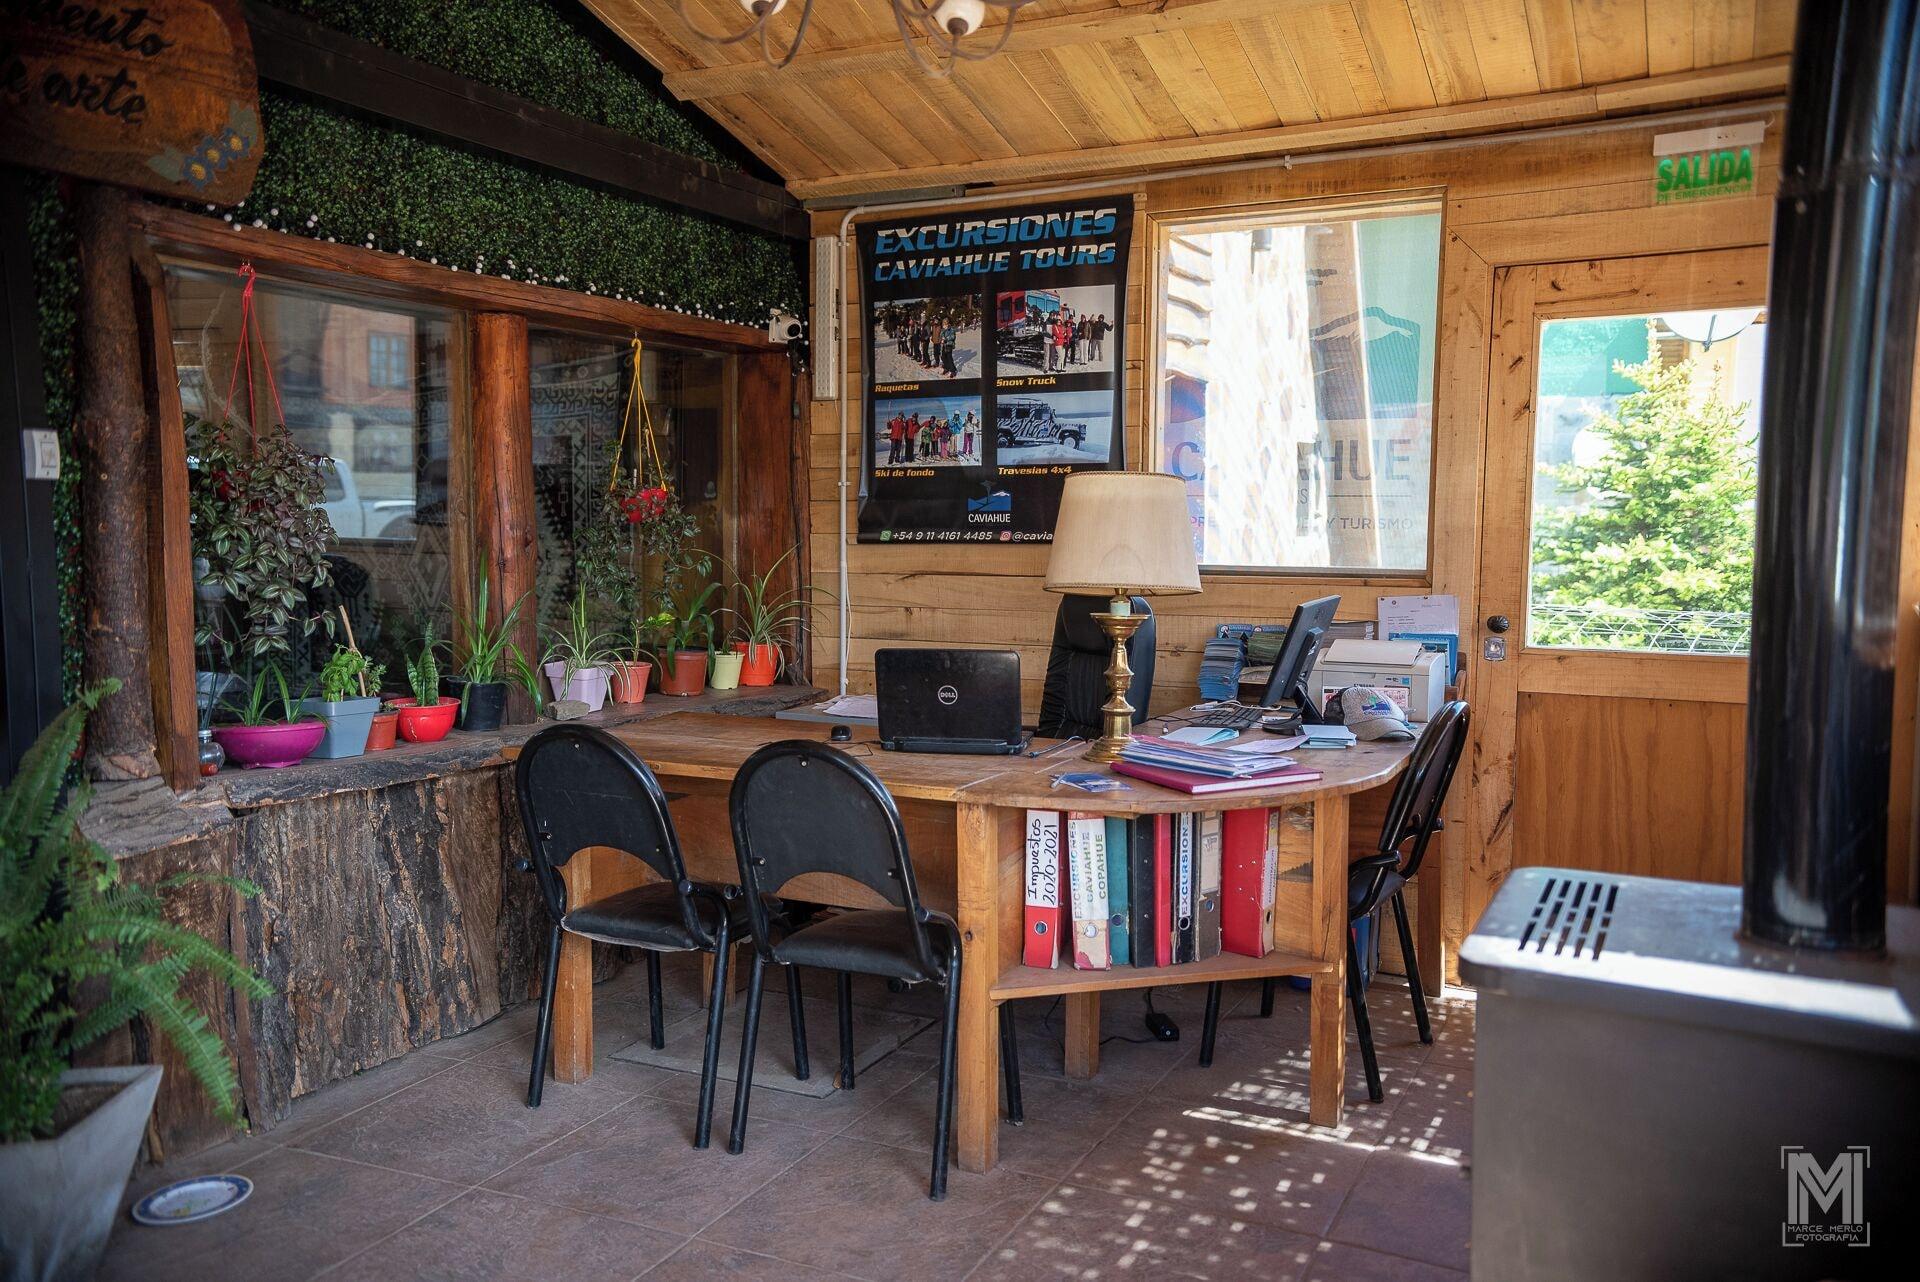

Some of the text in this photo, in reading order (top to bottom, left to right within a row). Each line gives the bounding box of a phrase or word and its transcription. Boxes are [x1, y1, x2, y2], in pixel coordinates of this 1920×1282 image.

[43, 67, 146, 124] arte
[1657, 148, 1752, 191] SALIDA
[874, 208, 1117, 254] EXCURSIONES
[874, 242, 1116, 282] CAVIAHUE TOURS
[875, 383, 919, 393] Raquetas
[996, 376, 1056, 387] Snow Truck
[875, 468, 935, 477] Ski de fondo
[998, 465, 1072, 475] Travesias 4x4
[893, 532, 915, 540] +54
[915, 531, 924, 540] 9
[926, 531, 935, 540] 11
[937, 531, 960, 540] 4161
[963, 531, 993, 540] 4485
[968, 513, 1011, 523] CAVIAHUE
[1027, 818, 1042, 899] Impuestos
[1042, 824, 1059, 905] 2020-2021
[1069, 822, 1083, 919] EXCURSIONES
[1082, 832, 1094, 903] CAVIAHUE
[1095, 834, 1107, 900] COPAHUE
